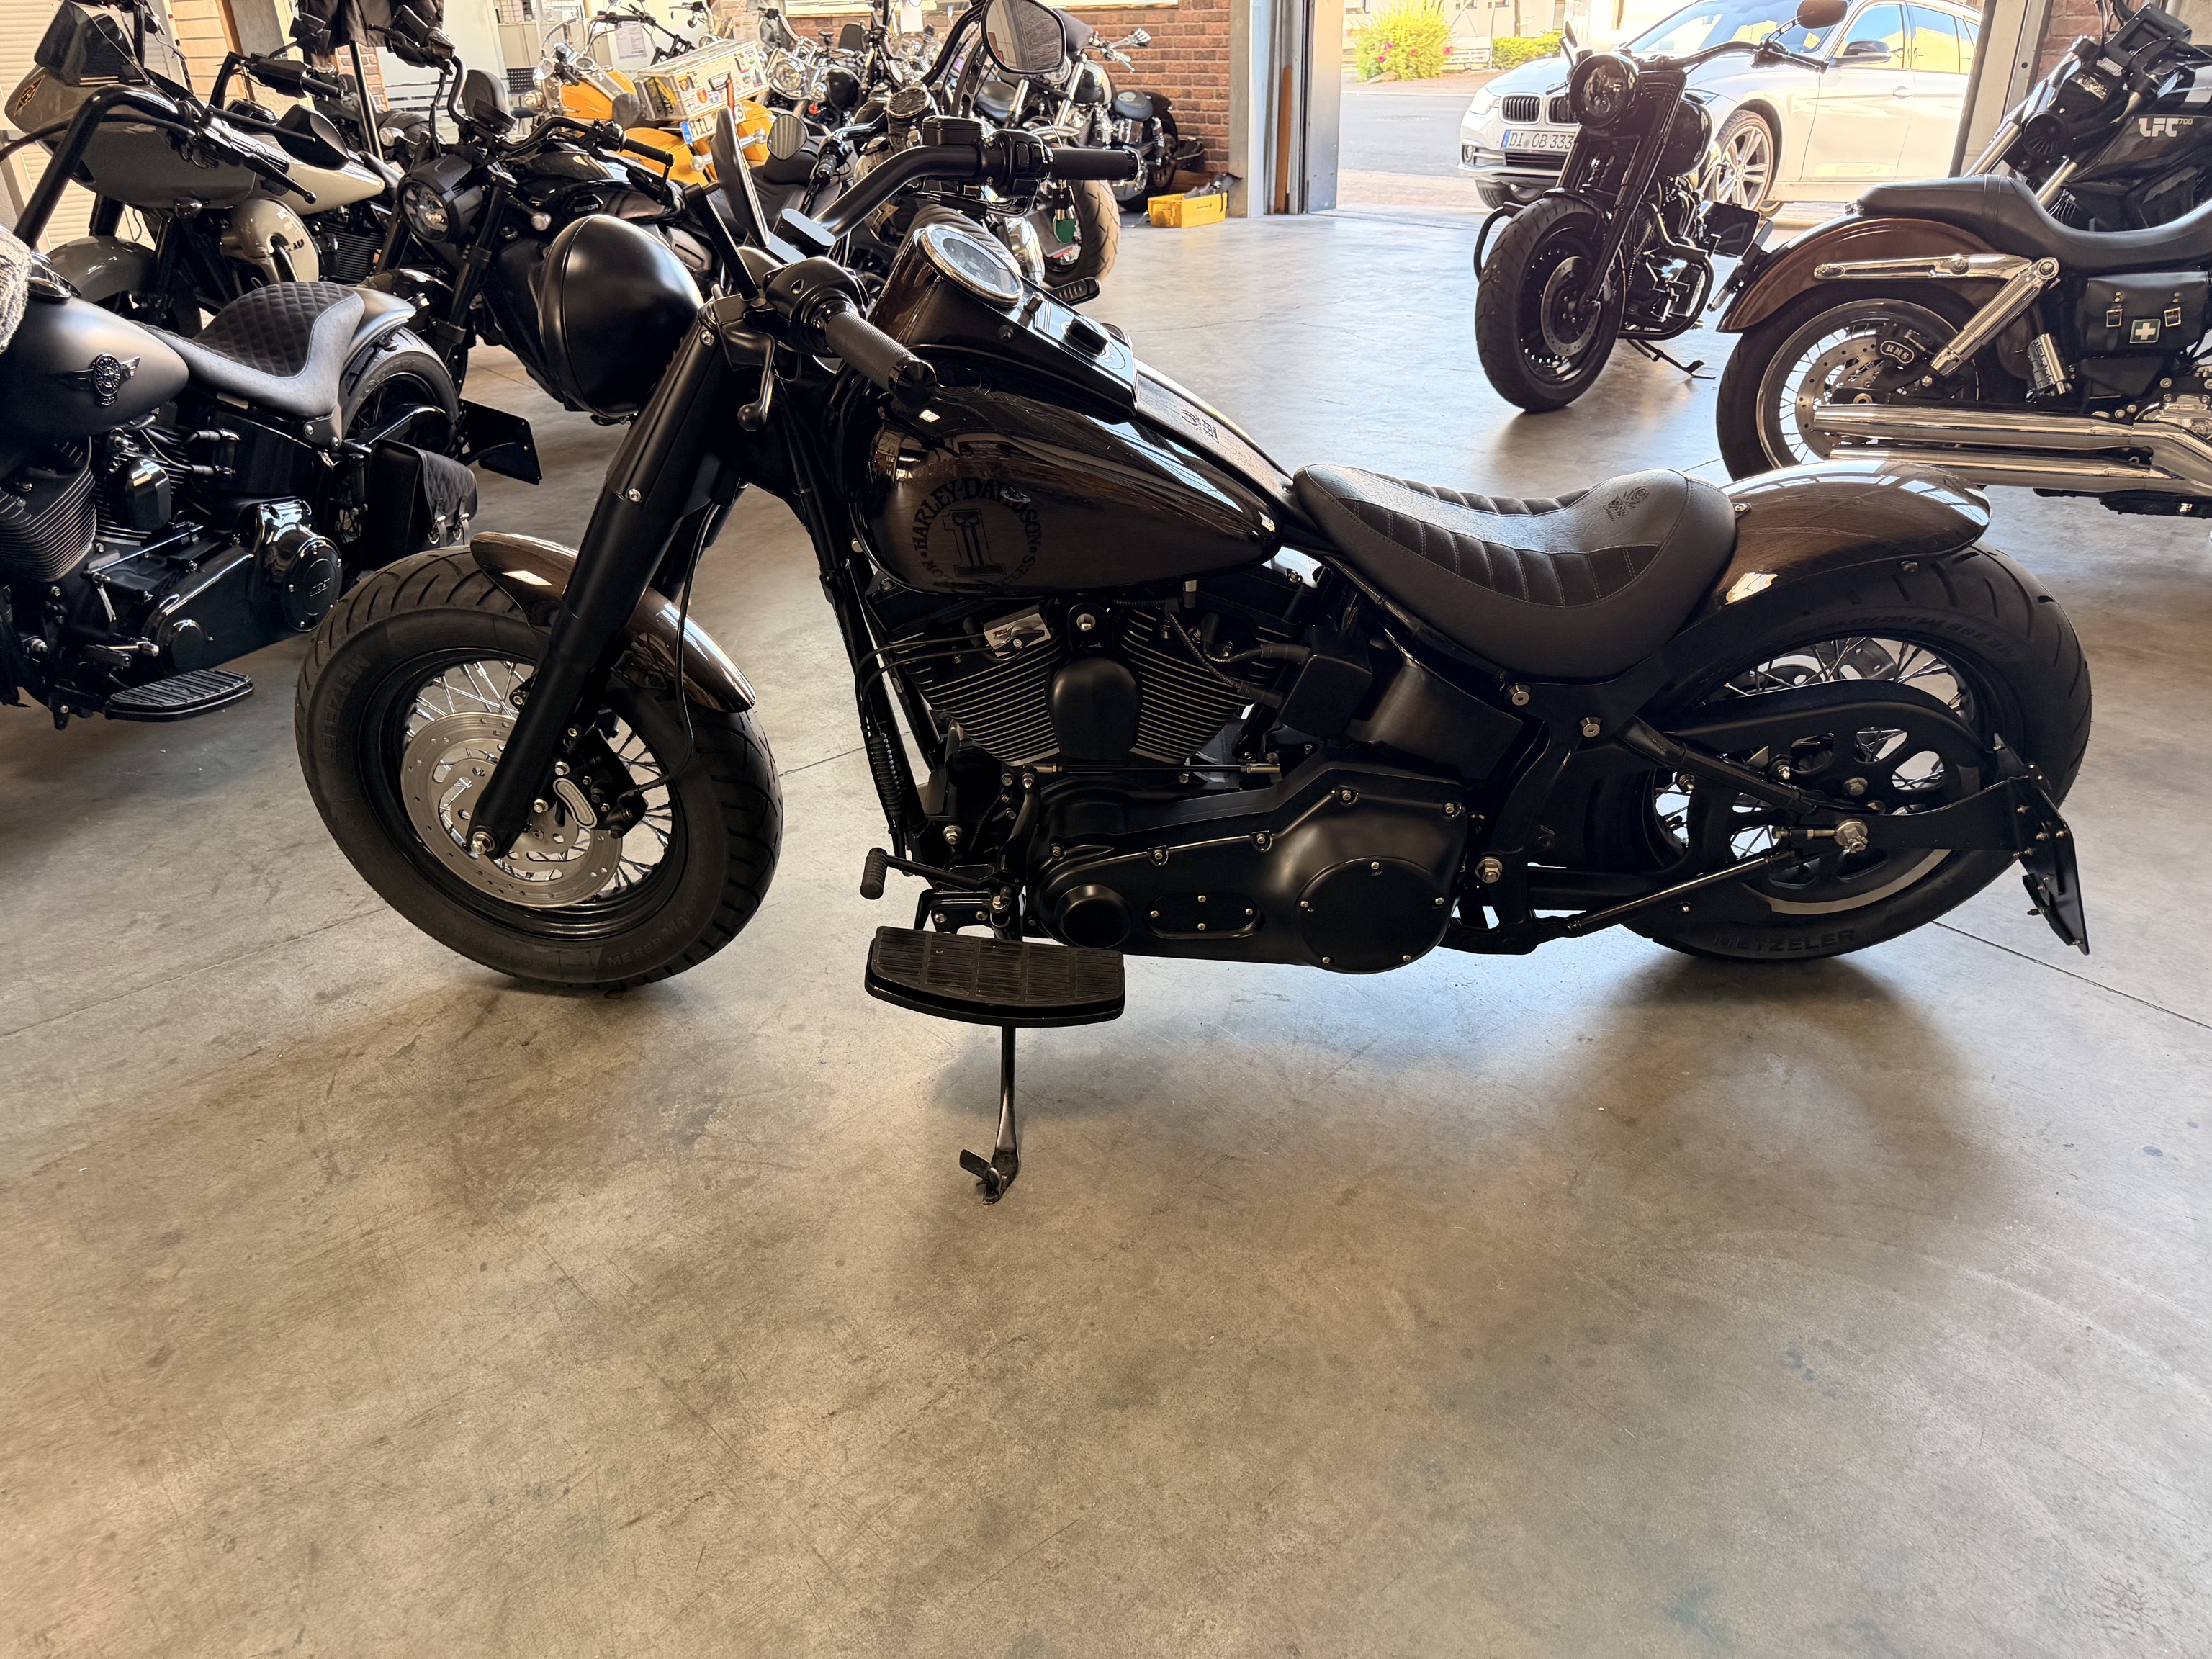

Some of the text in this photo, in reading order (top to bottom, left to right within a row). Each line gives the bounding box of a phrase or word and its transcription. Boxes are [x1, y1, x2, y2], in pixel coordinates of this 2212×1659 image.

[1509, 132, 1574, 150] DI OB 333
[1886, 344, 1910, 359] RMS
[321, 655, 371, 763] METZELER
[1714, 929, 1856, 952] METZELER
